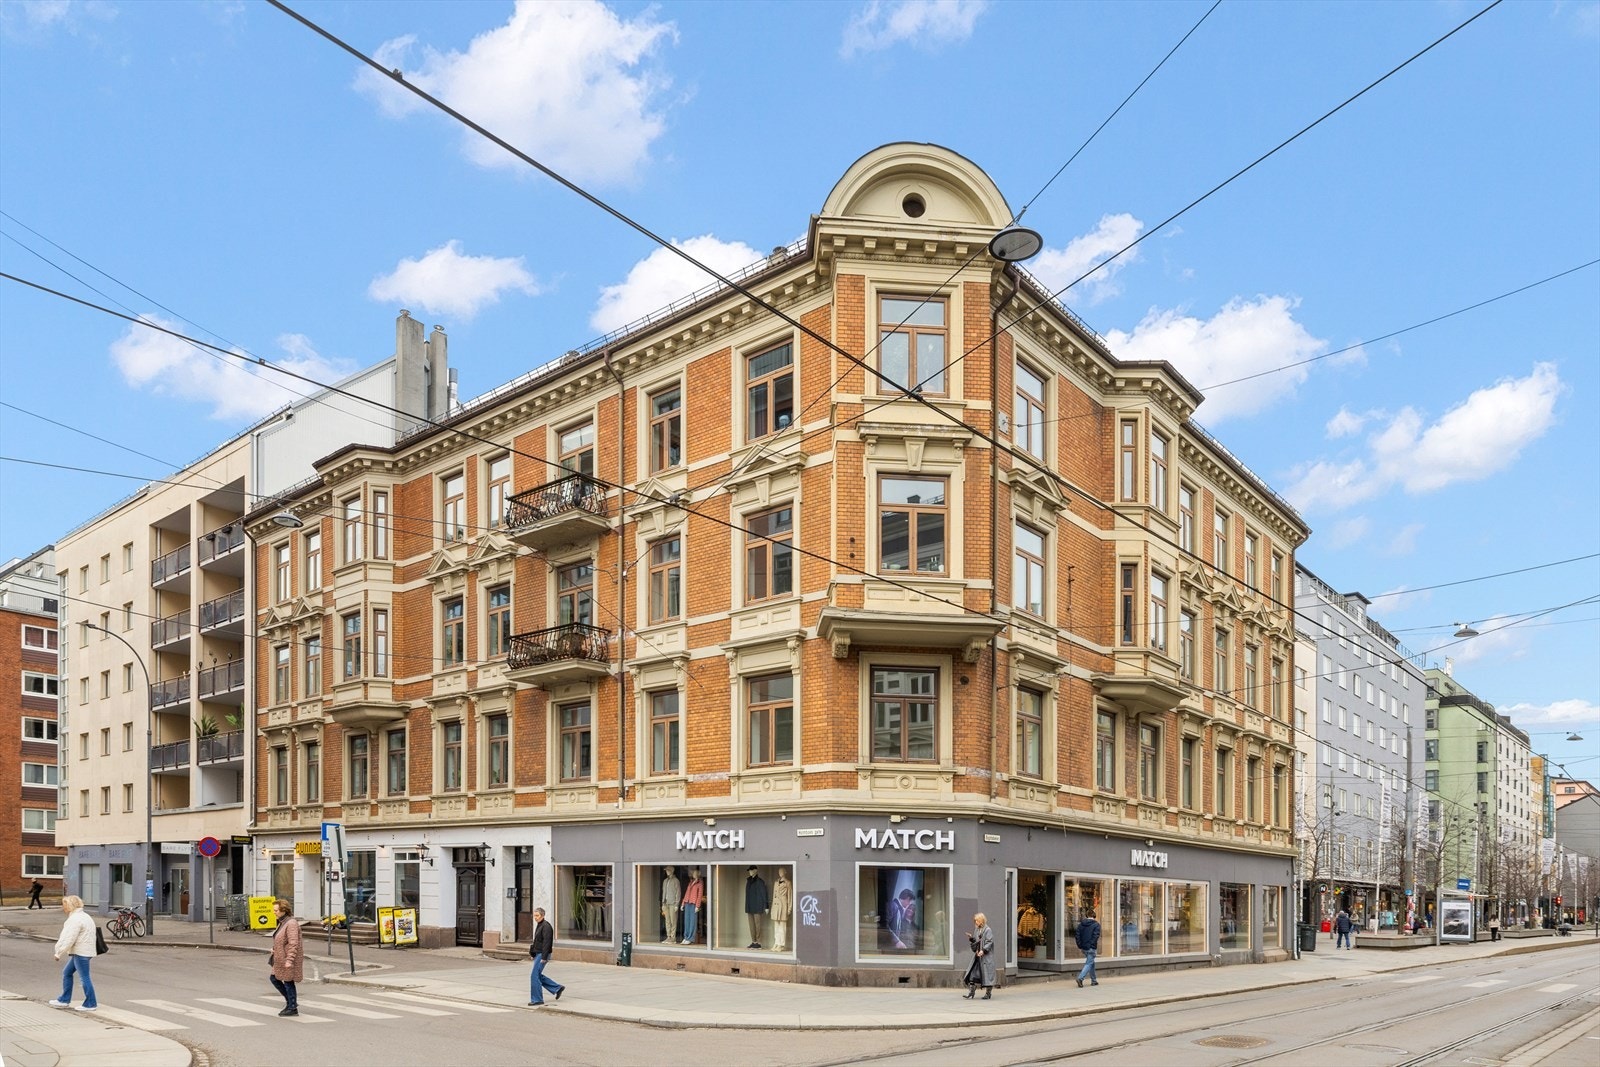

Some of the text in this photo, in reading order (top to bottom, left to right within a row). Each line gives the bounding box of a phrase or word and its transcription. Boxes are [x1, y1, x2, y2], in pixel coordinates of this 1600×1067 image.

[676, 829, 745, 850] MATCH
[855, 827, 955, 850] MATCH
[1131, 849, 1168, 868] MATCH
